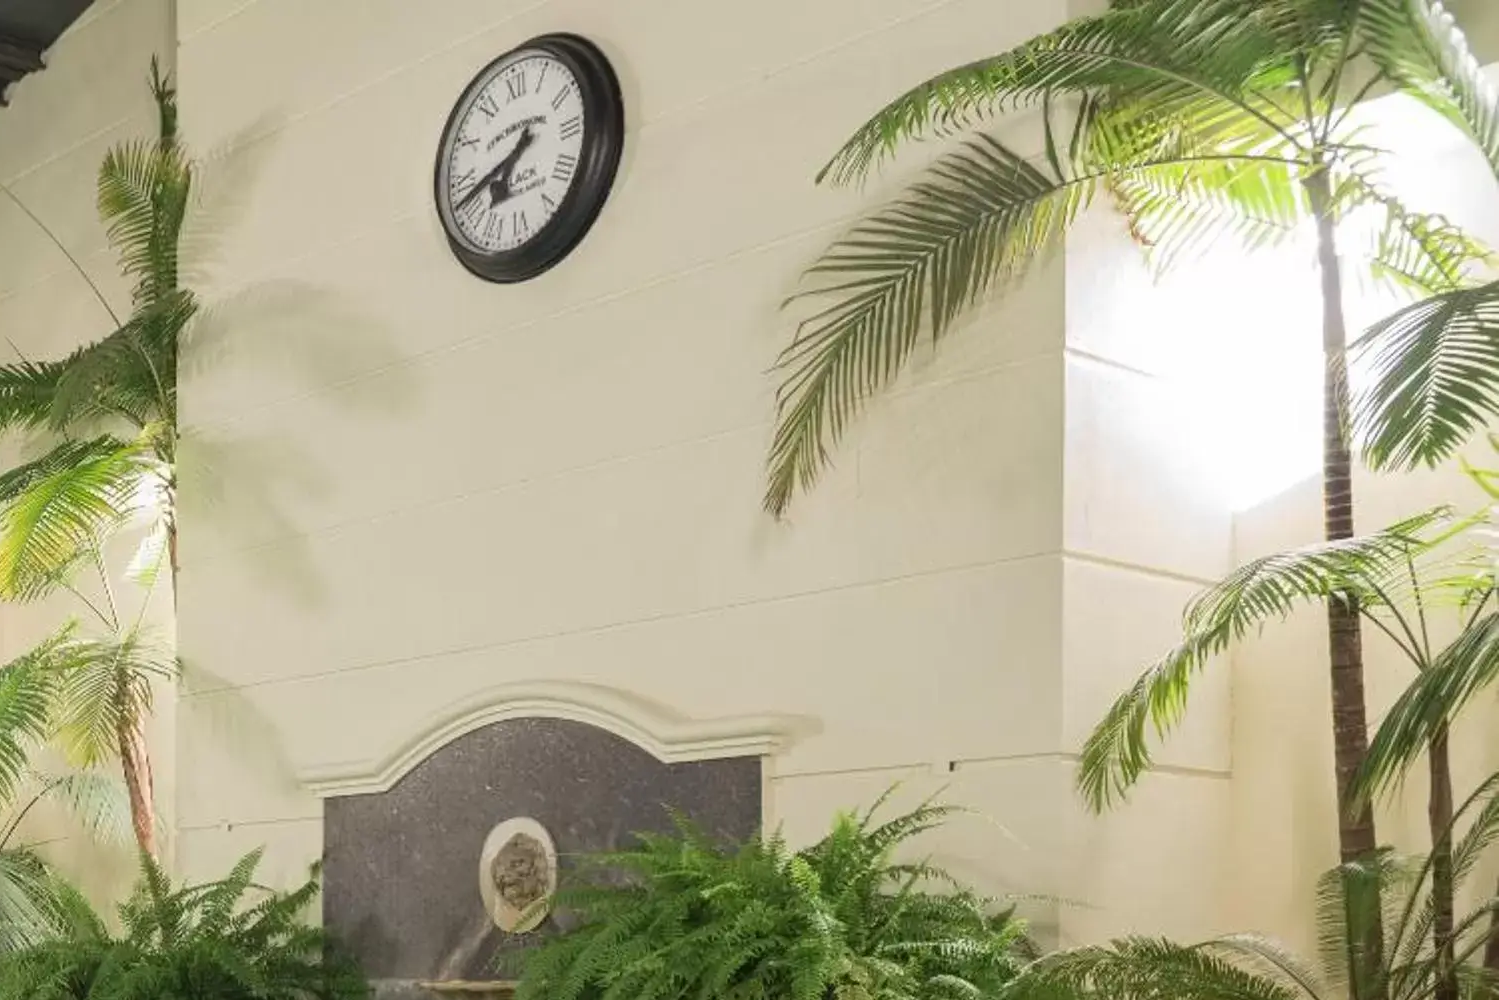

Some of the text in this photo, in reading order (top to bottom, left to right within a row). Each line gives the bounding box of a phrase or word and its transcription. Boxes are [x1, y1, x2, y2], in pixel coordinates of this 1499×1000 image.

[506, 71, 526, 105] XII
[552, 84, 571, 111] II
[559, 115, 582, 142] III
